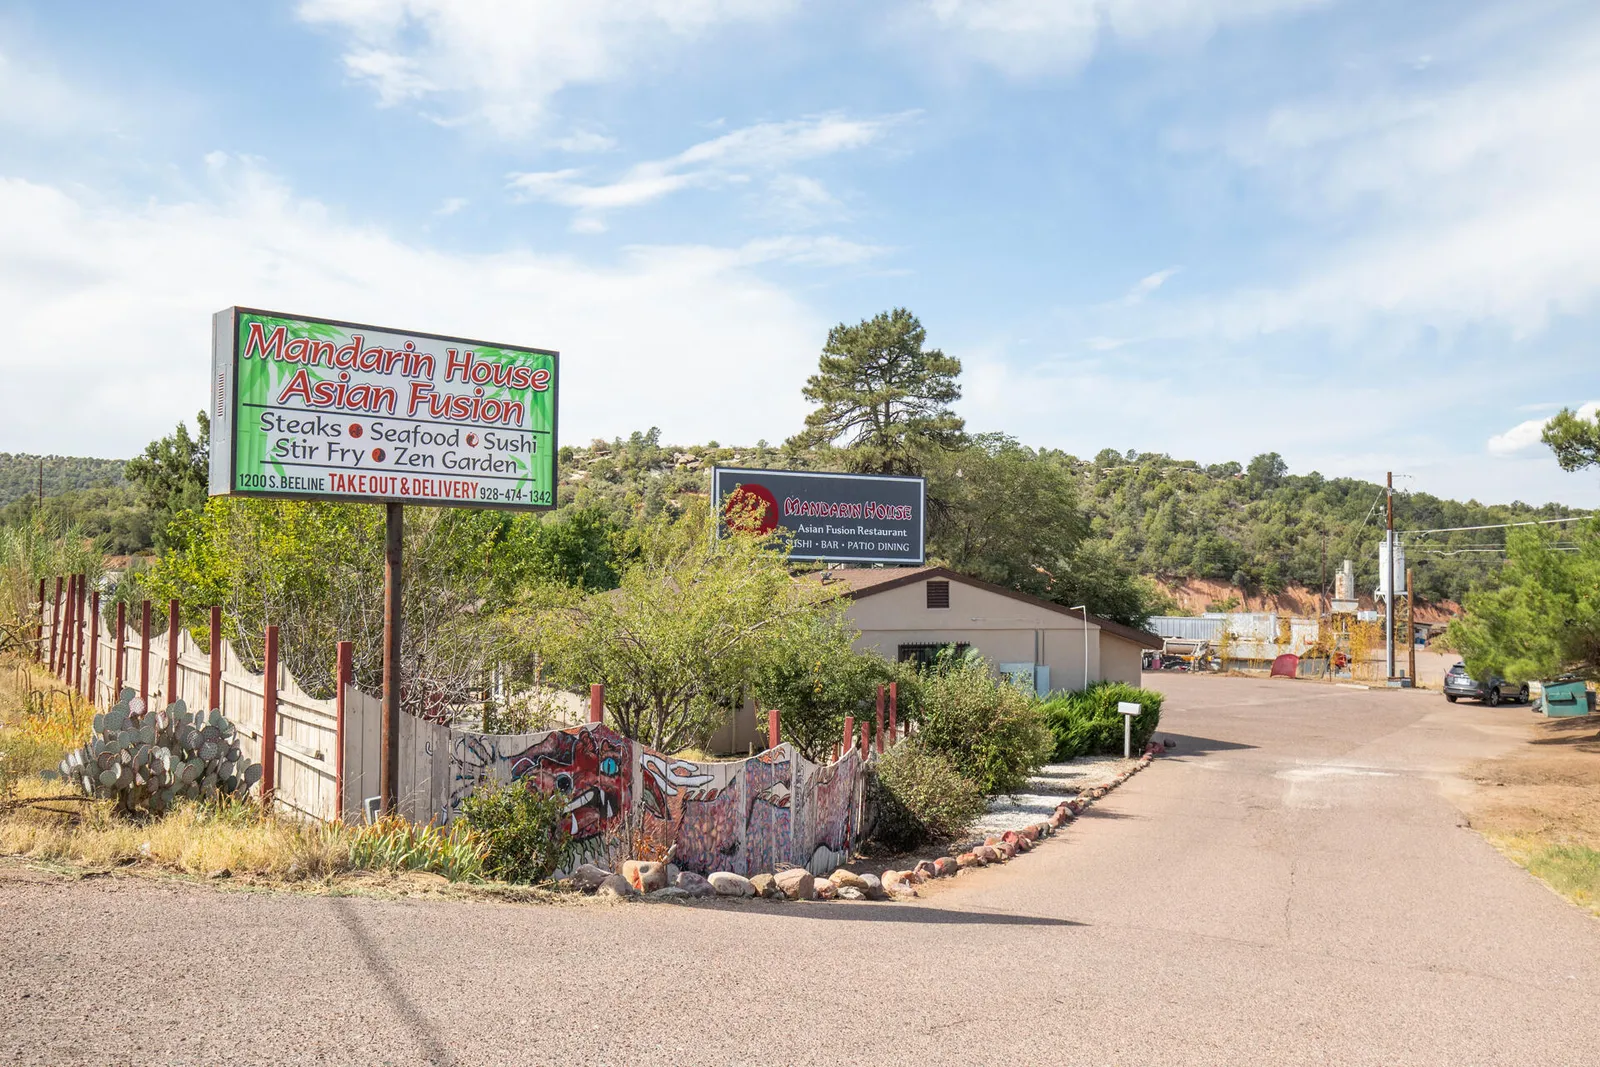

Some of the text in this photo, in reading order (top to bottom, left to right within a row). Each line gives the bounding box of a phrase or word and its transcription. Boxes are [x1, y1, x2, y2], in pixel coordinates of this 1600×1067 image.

[243, 322, 551, 392] Mandarin House
[277, 367, 525, 428] Asian Fusion
[260, 412, 537, 453] Steaks Seafood Sushi
[275, 438, 517, 474] Stir Fry Zen Garden
[239, 473, 267, 488] 1200
[480, 487, 551, 503] 928-474-1342
[784, 497, 912, 520] MANDARIN HOUSE
[798, 523, 908, 537] Asian Fusion Restaurant
[821, 540, 839, 549] BAR
[847, 541, 875, 550] PATIO
[877, 542, 910, 552] DINING
